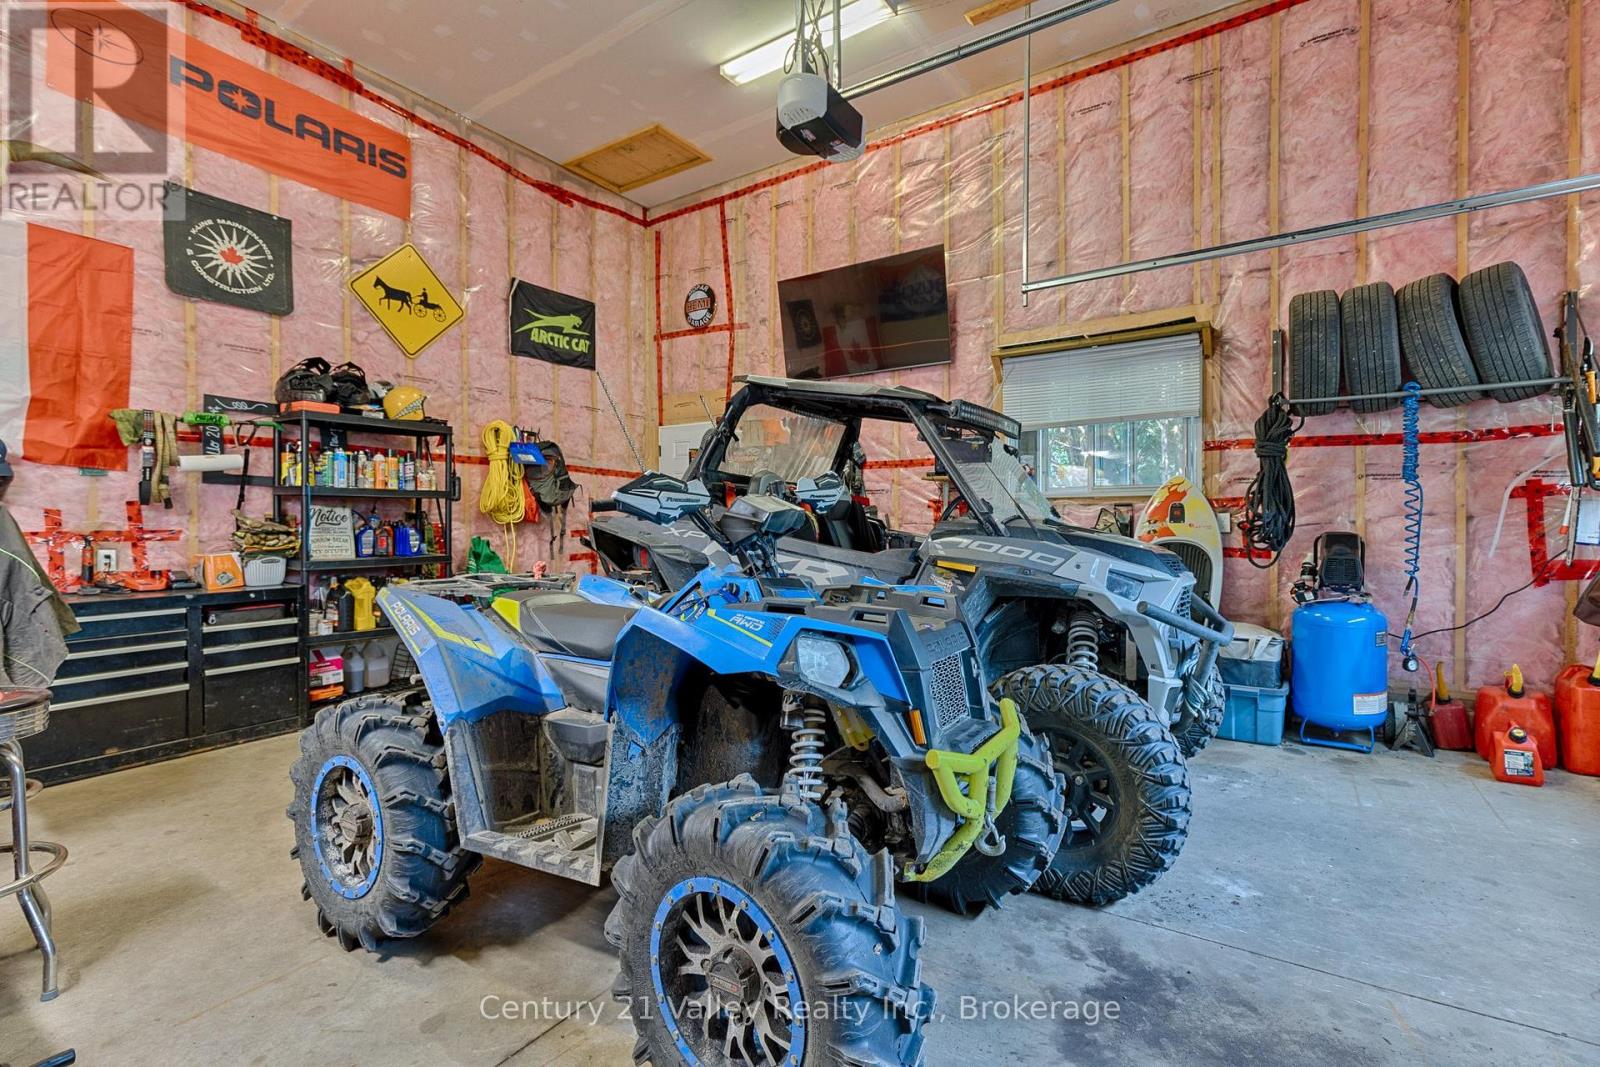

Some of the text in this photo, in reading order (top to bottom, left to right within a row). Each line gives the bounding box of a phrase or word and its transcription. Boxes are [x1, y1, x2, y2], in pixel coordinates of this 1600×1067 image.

[169, 55, 407, 179] POLARIS
[217, 219, 274, 260] MAINTENANCE
[191, 260, 263, 294] CONSTRUCTION
[687, 311, 713, 327] GARAGE
[530, 327, 590, 353] ARCTIC CAT
[310, 508, 349, 527] Notice
[663, 527, 708, 538] XP
[929, 536, 1065, 567] 1000
[391, 601, 420, 636] POLARIS
